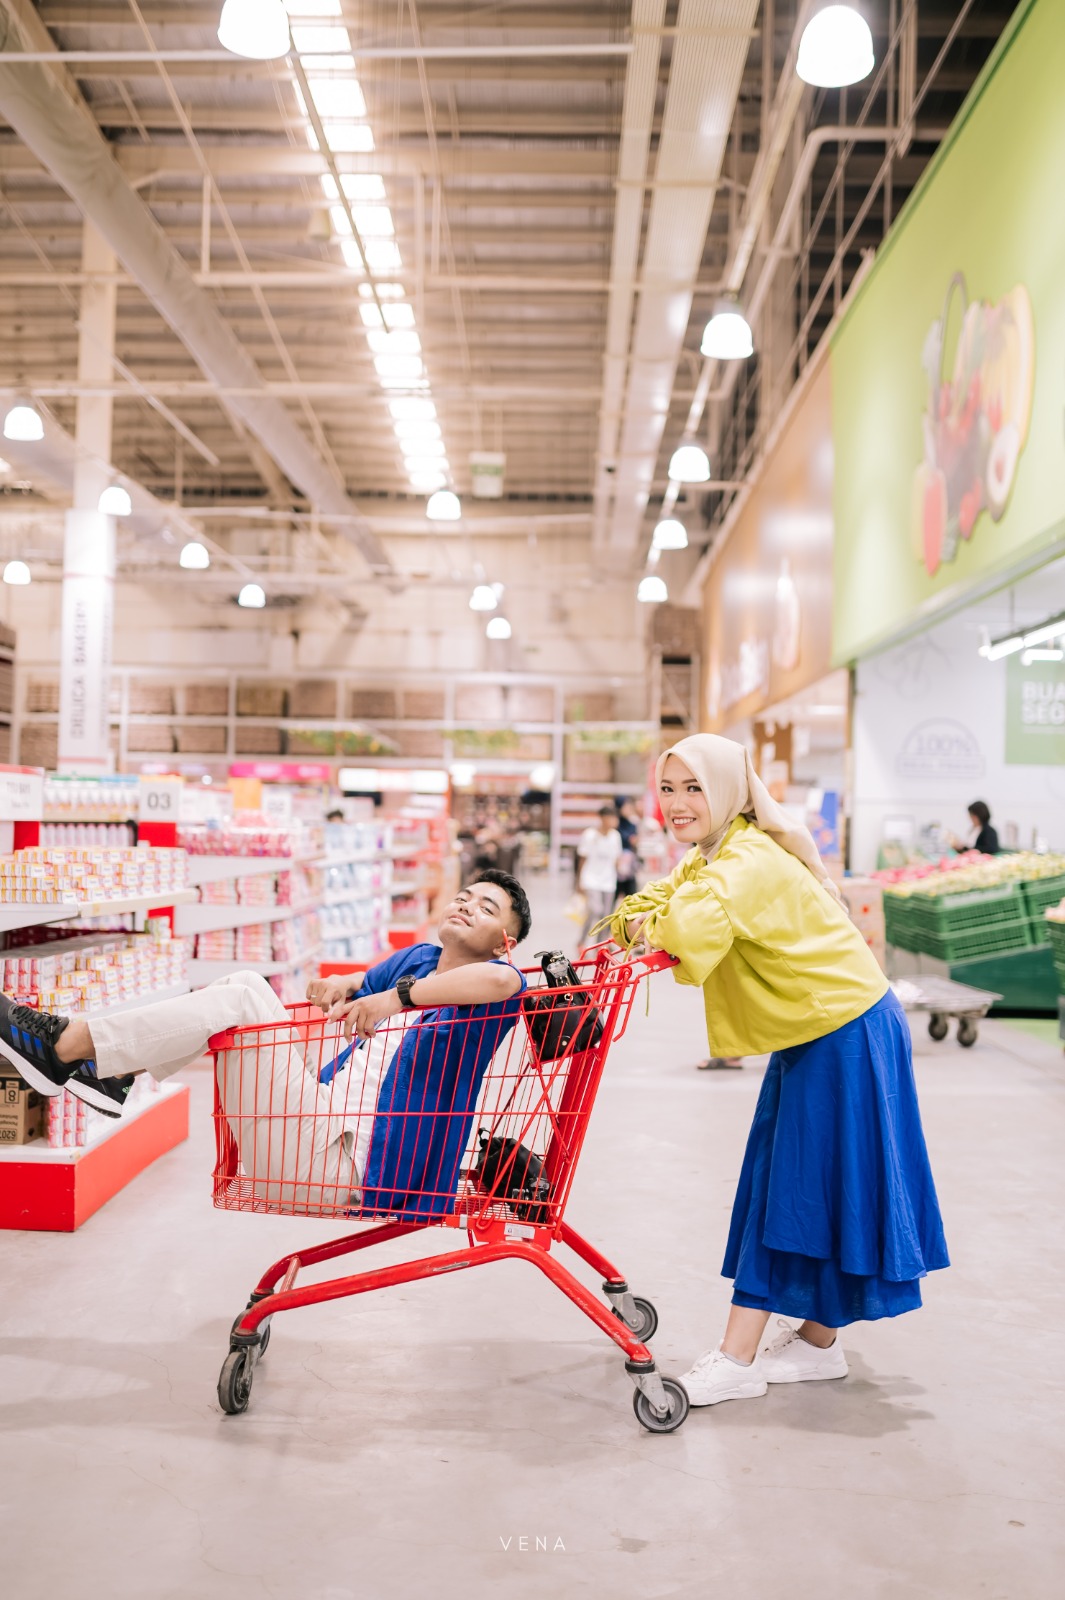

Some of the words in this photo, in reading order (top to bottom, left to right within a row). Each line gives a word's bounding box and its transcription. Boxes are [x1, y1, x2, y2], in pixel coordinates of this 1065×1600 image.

[915, 733, 972, 756] 100%
[147, 792, 171, 811] 03
[8, 1090, 16, 1102] 8
